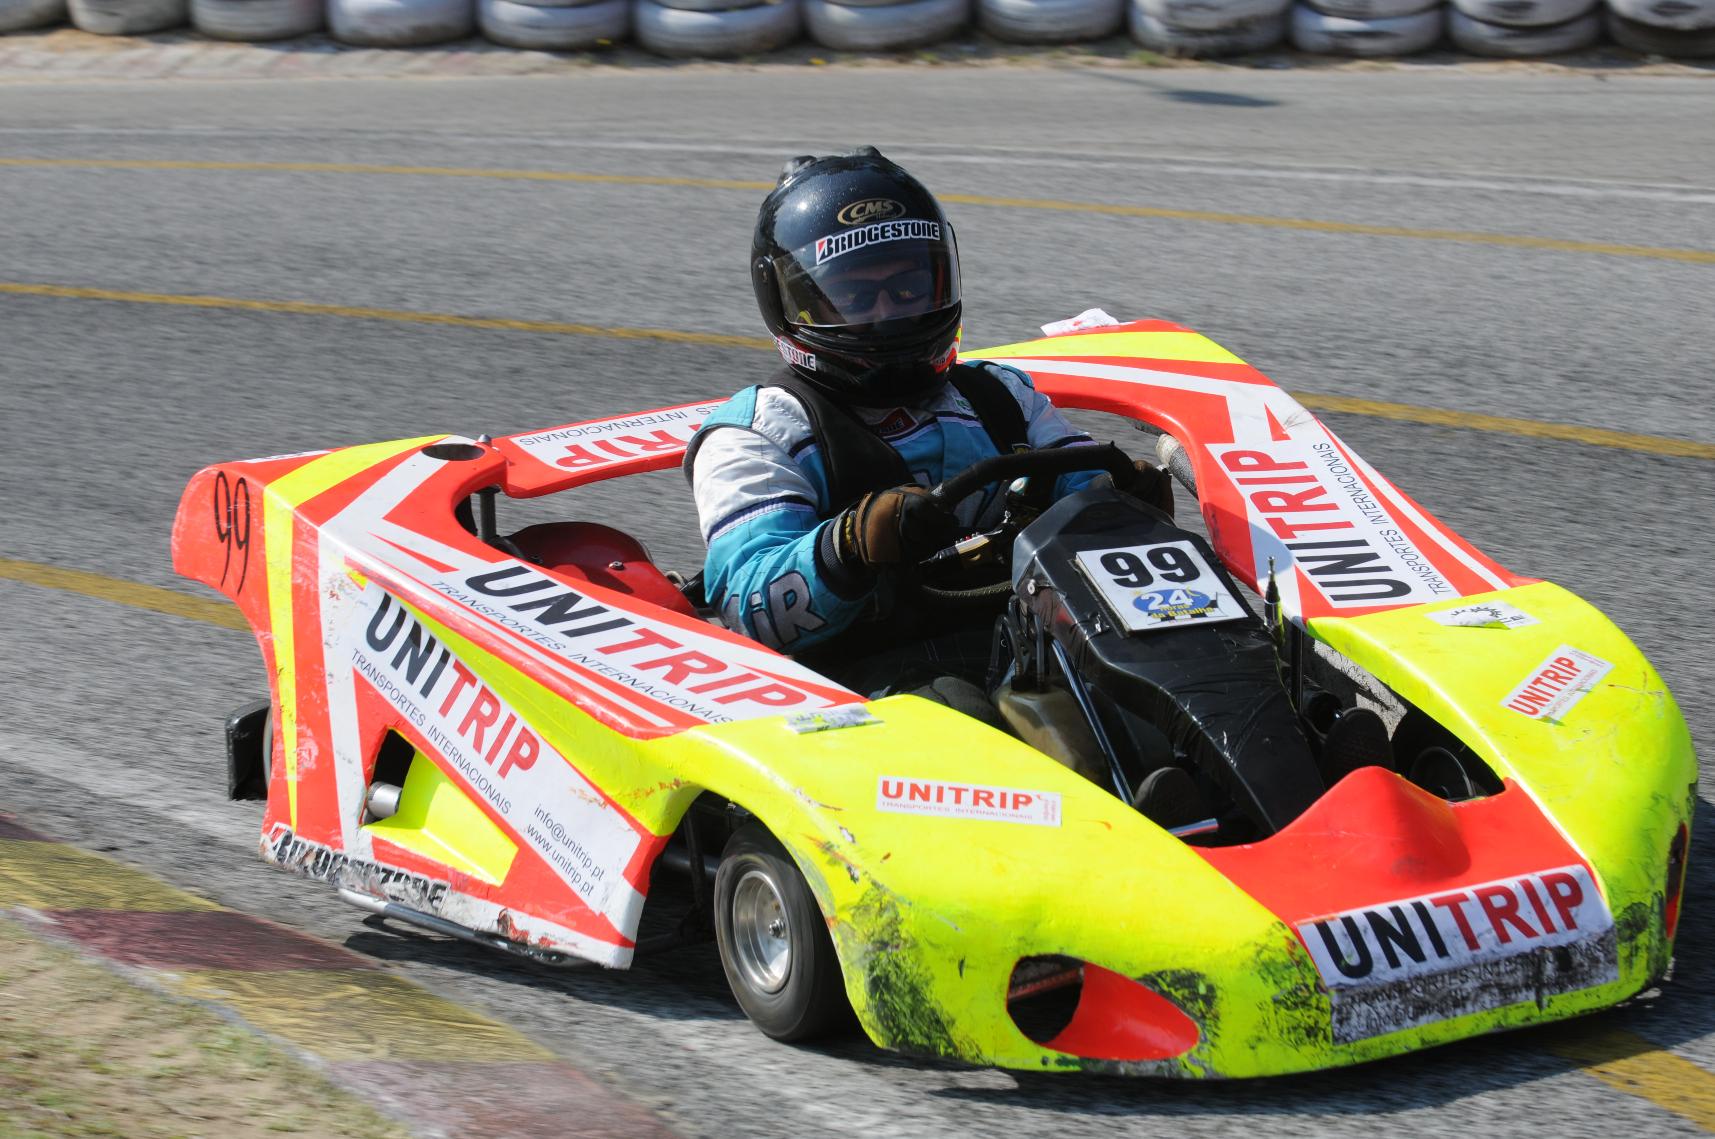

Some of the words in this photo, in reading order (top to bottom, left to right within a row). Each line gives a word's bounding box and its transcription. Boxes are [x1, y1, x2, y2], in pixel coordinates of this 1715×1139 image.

[818, 221, 940, 263] BRIDGESTONE
[850, 200, 894, 219] CMS
[519, 410, 688, 446] INTERNACIONAIS
[555, 424, 702, 468] RIP
[1312, 443, 1389, 525] INTERNACIONAIS
[214, 470, 250, 596] 99
[1220, 450, 1412, 602] UNITRIP
[1380, 529, 1451, 595] TRANSPORTES
[1099, 546, 1201, 588] 99
[1141, 589, 1194, 610] 24
[432, 581, 566, 651] TRANSPORTES
[567, 653, 736, 724] INTERNACIONAIS
[464, 565, 808, 708] UNITRIP
[366, 592, 541, 779] UNITRIP
[1508, 656, 1585, 716] UNITRIP
[351, 648, 426, 727] TRANSPORTES
[427, 724, 512, 815] INTERNACIONAIS
[881, 780, 1034, 811] UNITRIP
[527, 824, 594, 896] www.unitrip.pt
[534, 803, 605, 881] info@unitrip.pt
[1313, 873, 1585, 979] UNITRIP
